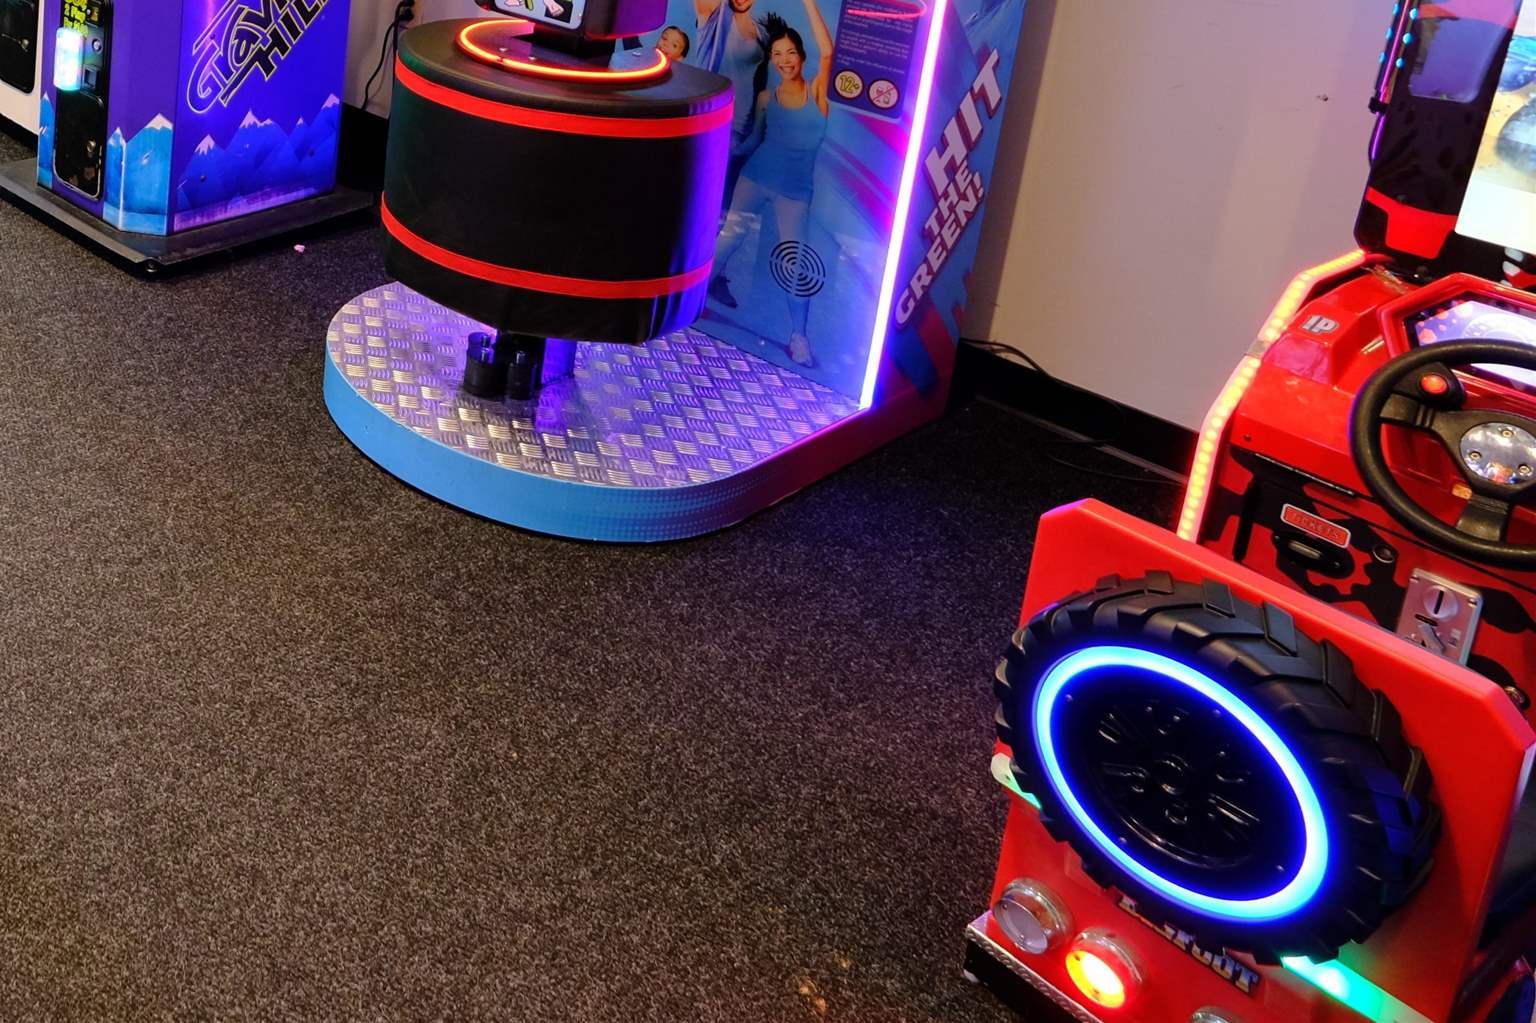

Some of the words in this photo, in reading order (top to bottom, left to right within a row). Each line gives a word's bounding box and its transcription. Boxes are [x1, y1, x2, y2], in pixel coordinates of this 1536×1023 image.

[924, 48, 1002, 198] HIT
[895, 171, 984, 330] GREEN!
[923, 159, 972, 244] THE
[1301, 315, 1339, 334] 1P
